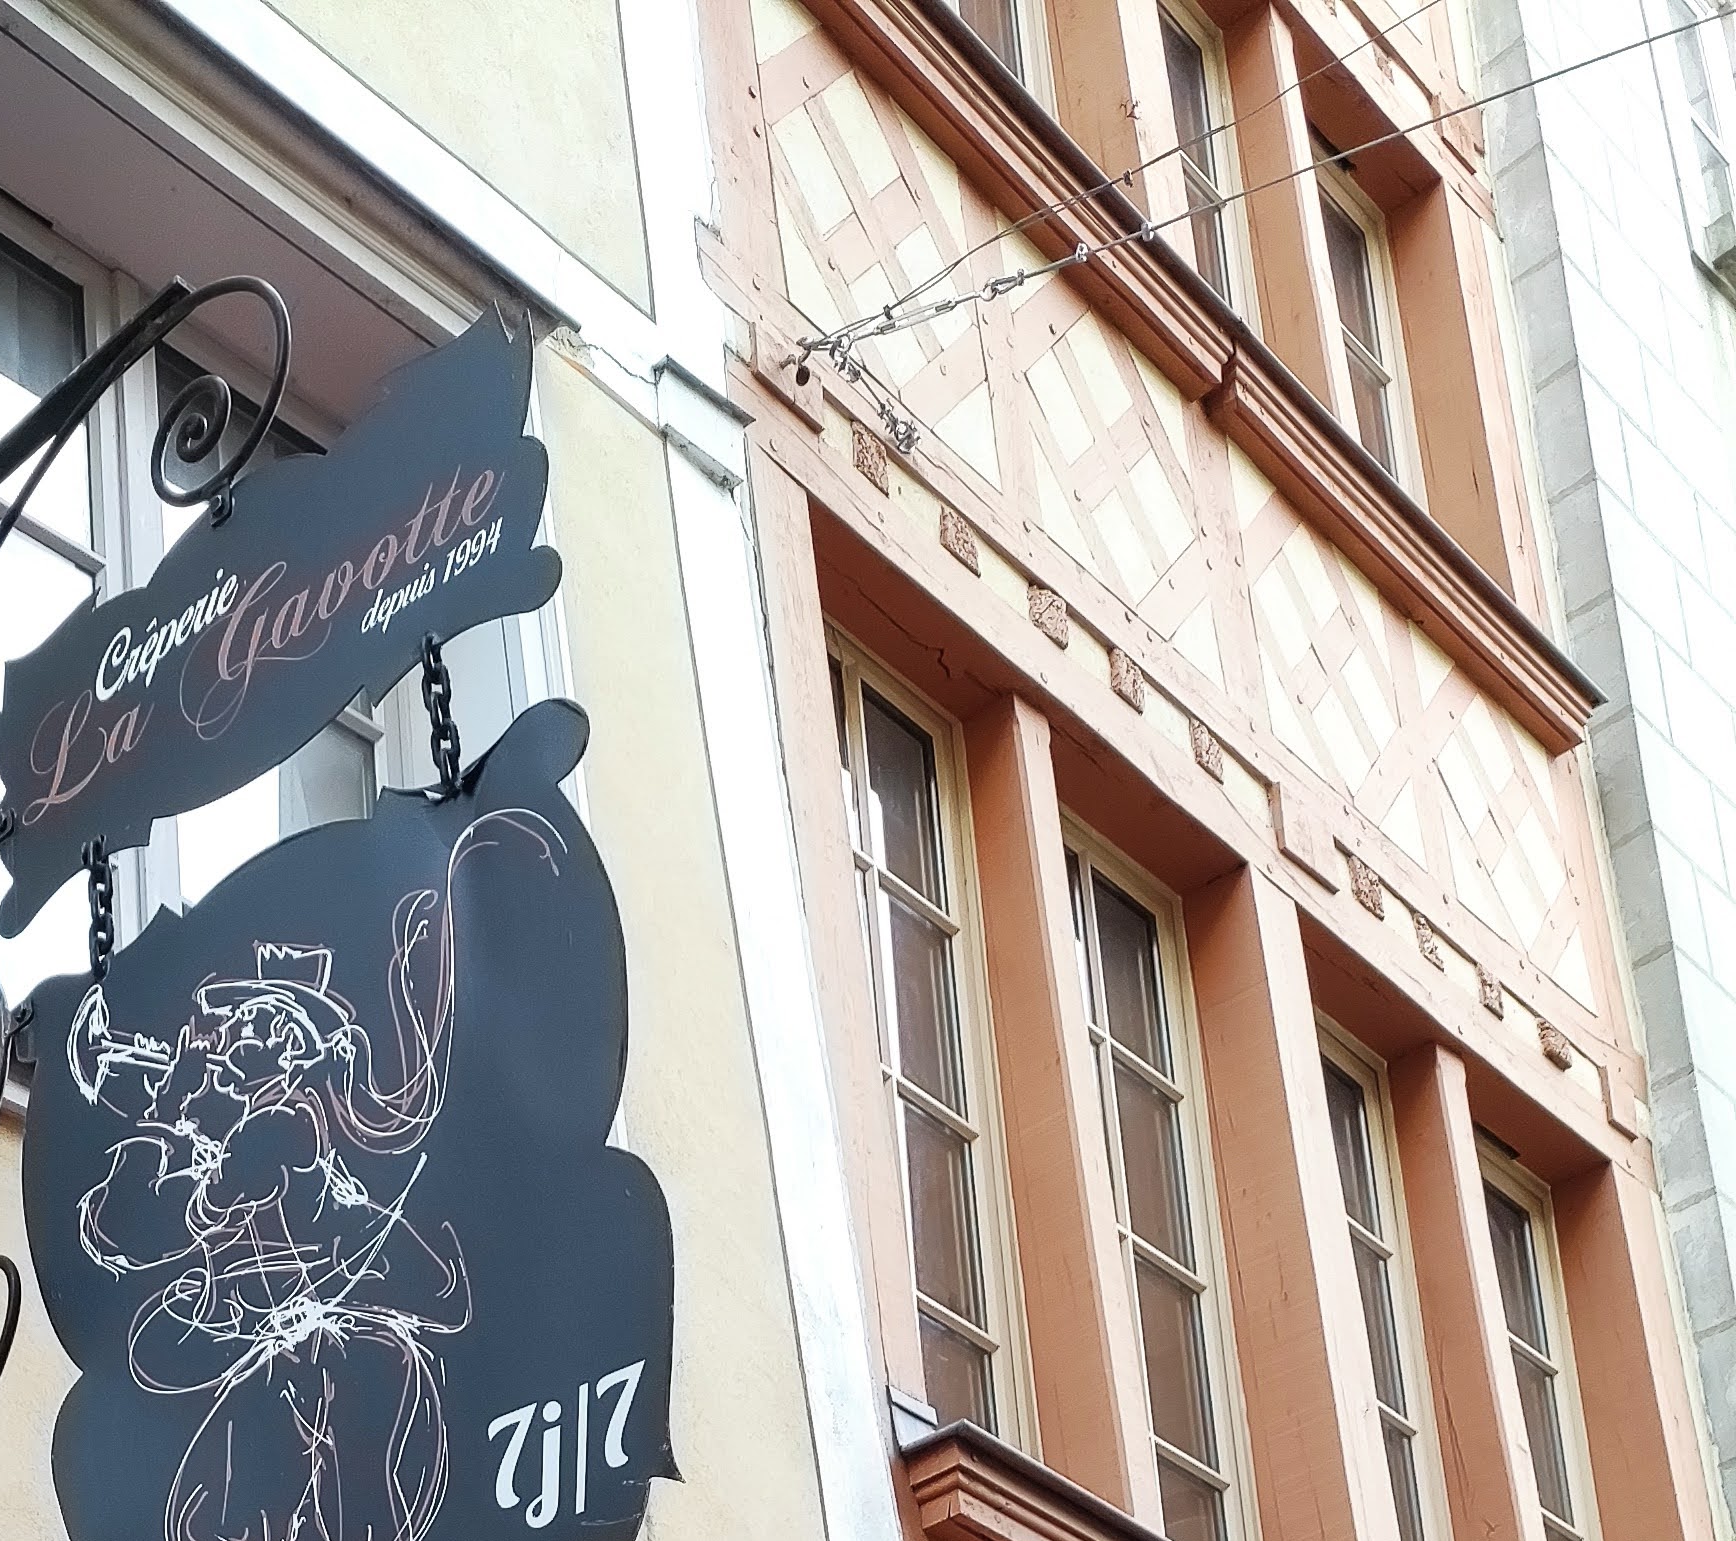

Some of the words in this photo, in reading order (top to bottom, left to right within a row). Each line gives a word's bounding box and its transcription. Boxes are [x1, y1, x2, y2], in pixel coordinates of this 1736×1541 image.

[96, 567, 239, 701] Crêperie
[361, 562, 436, 634] depuis
[441, 518, 503, 582] 1994
[23, 690, 154, 824] La
[180, 465, 504, 739] Gavotte
